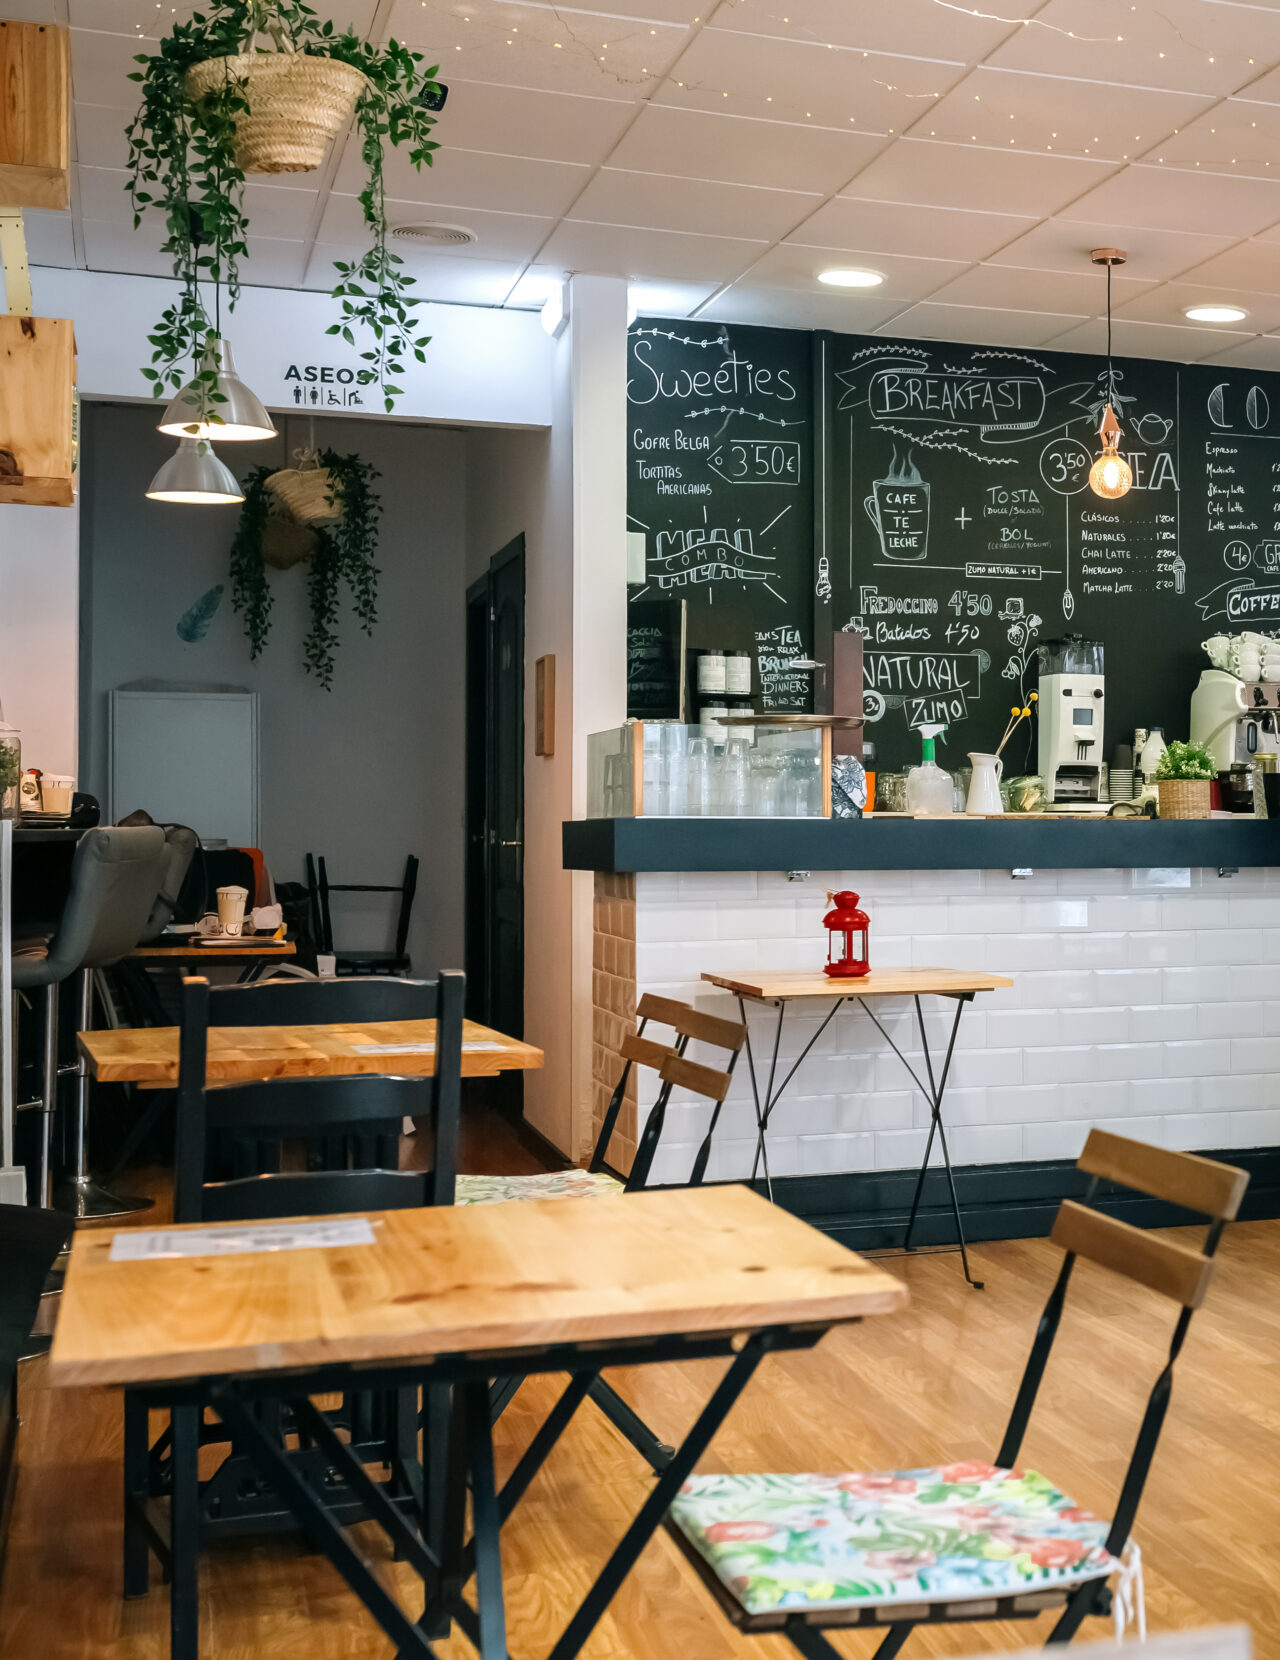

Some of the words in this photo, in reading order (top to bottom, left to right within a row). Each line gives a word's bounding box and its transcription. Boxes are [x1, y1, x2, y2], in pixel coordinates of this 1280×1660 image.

[284, 365, 370, 386] ASEOS
[626, 340, 796, 404] Sweeties
[877, 374, 1038, 421] BREAKFAST
[633, 428, 671, 450] GOFRE
[674, 429, 710, 450] BELGA
[635, 459, 683, 480] TORTITAS
[1095, 451, 1180, 491] EA
[657, 480, 713, 496] AMERICANAS
[986, 485, 1040, 505] TOSTA
[886, 493, 917, 505] CAFE
[893, 516, 910, 528] TE
[889, 537, 918, 548] LECHE
[1000, 527, 1034, 542] BOL
[665, 548, 744, 571] COMBO
[1081, 547, 1103, 558] CHAI
[1105, 548, 1132, 559] LATTE
[967, 566, 986, 574] ZUMO
[988, 566, 1019, 575] NATURAL
[859, 585, 939, 615] FREDOCCINO
[947, 590, 993, 616] 4'50
[876, 621, 932, 643] Batidos
[761, 681, 809, 695] DINNERS
[910, 698, 963, 728] ZUMO
